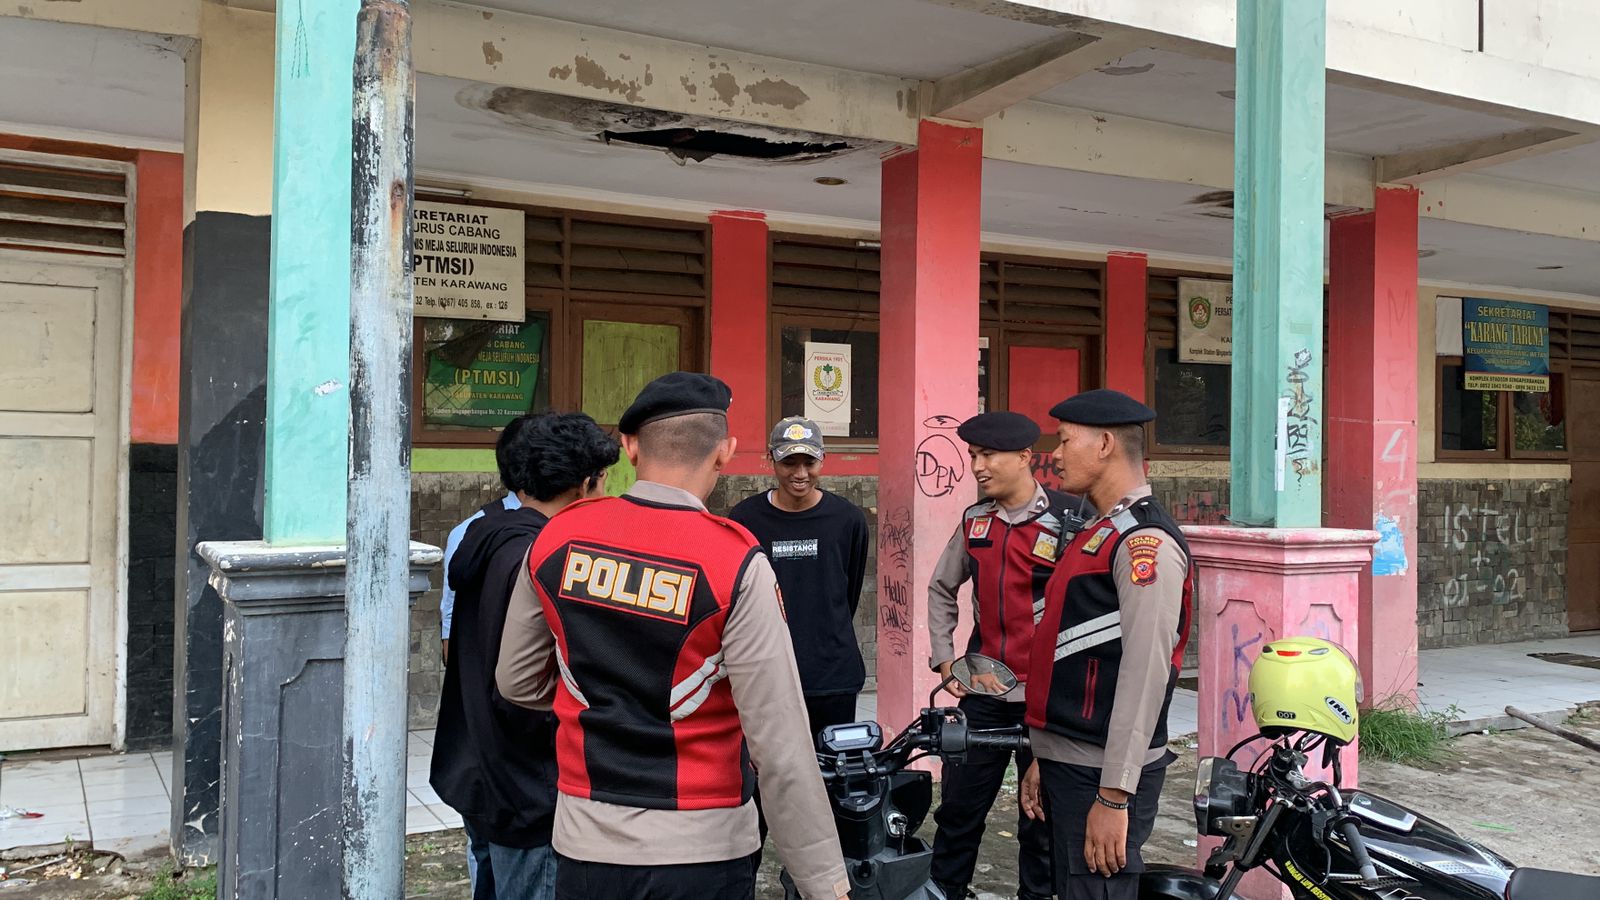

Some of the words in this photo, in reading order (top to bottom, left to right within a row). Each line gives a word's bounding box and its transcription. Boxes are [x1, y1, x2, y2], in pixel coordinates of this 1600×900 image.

[449, 225, 500, 240] CABANG
[425, 239, 444, 252] MEJA
[446, 241, 478, 255] SELURUH
[480, 243, 517, 258] INDONESIA
[413, 277, 436, 287] TEN
[441, 279, 508, 292] KARAWANG
[415, 296, 423, 306] 32
[458, 299, 468, 308] 405
[1477, 306, 1537, 320] SEKRETARIAT
[495, 324, 520, 335] RIAT
[494, 341, 525, 349] CABANG
[455, 369, 520, 387] (PTMSI)
[489, 392, 523, 400] KARAWANG
[772, 544, 818, 553] RESISTANCE
[563, 552, 693, 616] POLISI
[1278, 711, 1294, 719] DOT
[1328, 700, 1350, 720] INK
